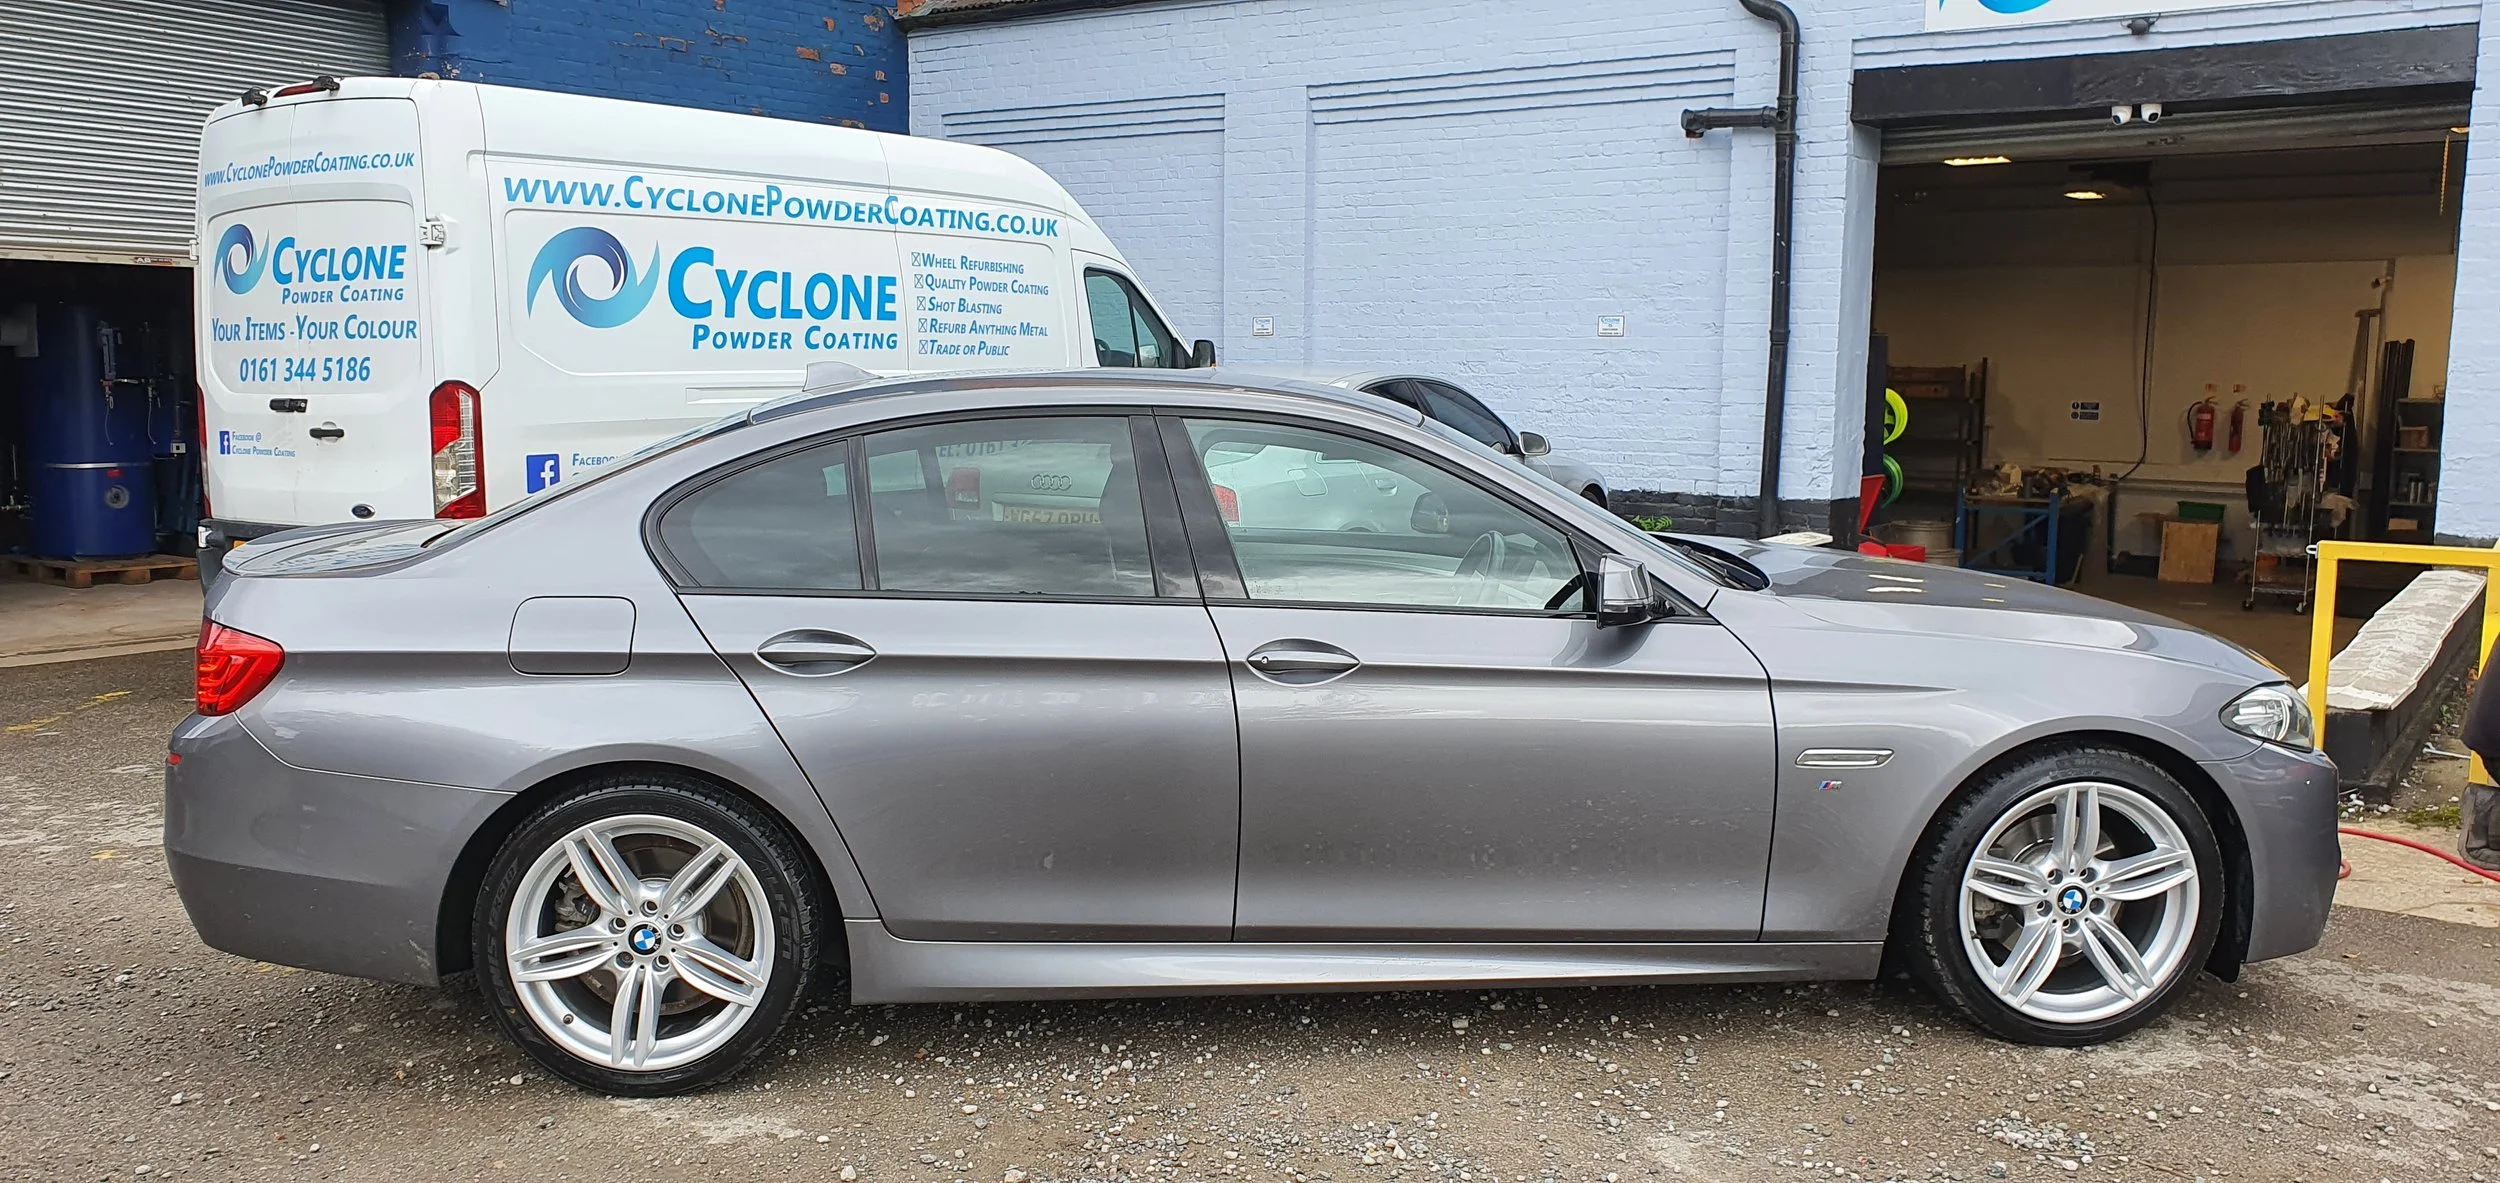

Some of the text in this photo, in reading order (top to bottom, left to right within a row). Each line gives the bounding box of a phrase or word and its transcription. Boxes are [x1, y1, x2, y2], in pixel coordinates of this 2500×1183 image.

[239, 356, 371, 382] 0161 344 5186
